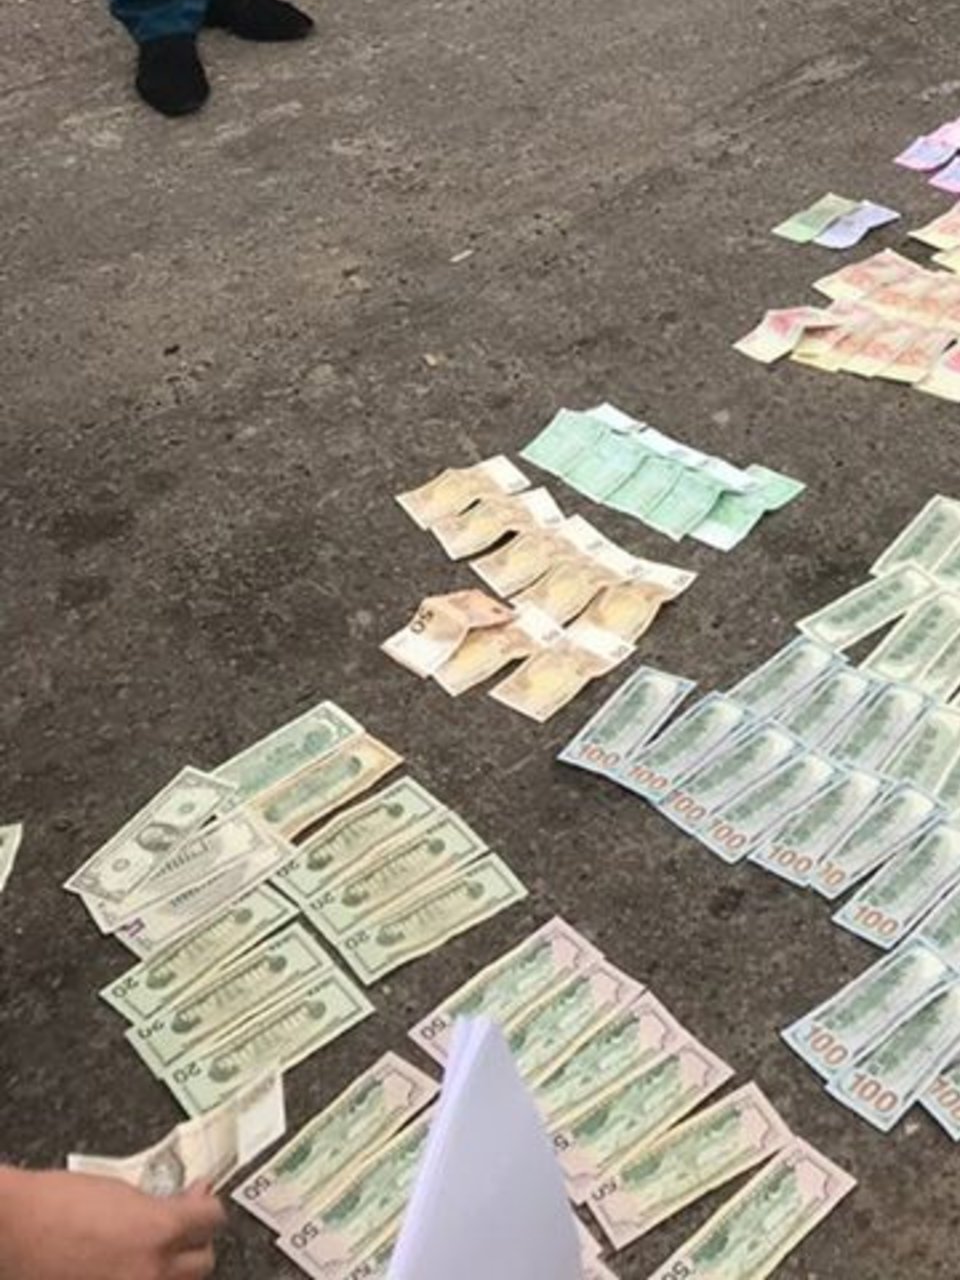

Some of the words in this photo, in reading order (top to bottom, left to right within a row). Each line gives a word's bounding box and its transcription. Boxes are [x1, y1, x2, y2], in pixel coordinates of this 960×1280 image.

[670, 790, 707, 820] 100
[709, 820, 747, 850] 100
[767, 845, 814, 872] 100
[853, 904, 900, 936] 100
[111, 975, 140, 999] 20
[419, 1018, 446, 1040] 50
[807, 1023, 849, 1066] 100
[172, 1061, 202, 1084] 20
[850, 1073, 898, 1113] 100
[242, 1176, 271, 1201] 50
[289, 1221, 320, 1251] 50
